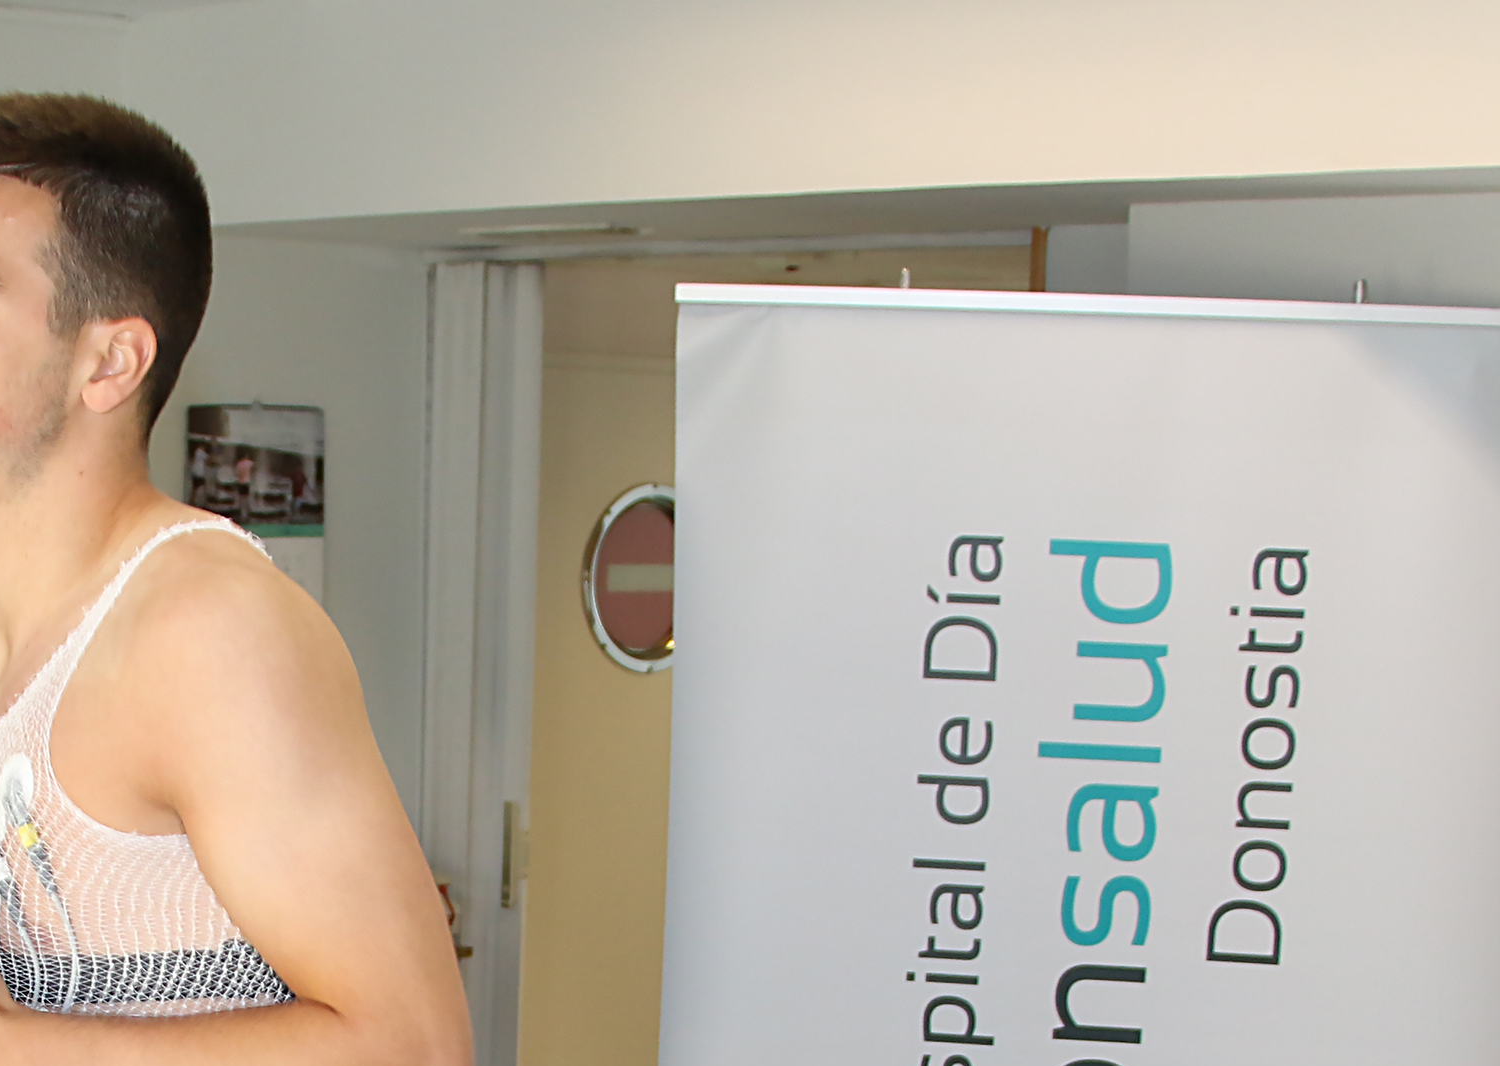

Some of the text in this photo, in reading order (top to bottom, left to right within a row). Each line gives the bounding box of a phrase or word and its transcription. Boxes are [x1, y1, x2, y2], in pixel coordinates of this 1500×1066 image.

[922, 534, 1005, 682] Día
[916, 716, 994, 825] de
[1206, 547, 1310, 966] Donostia
